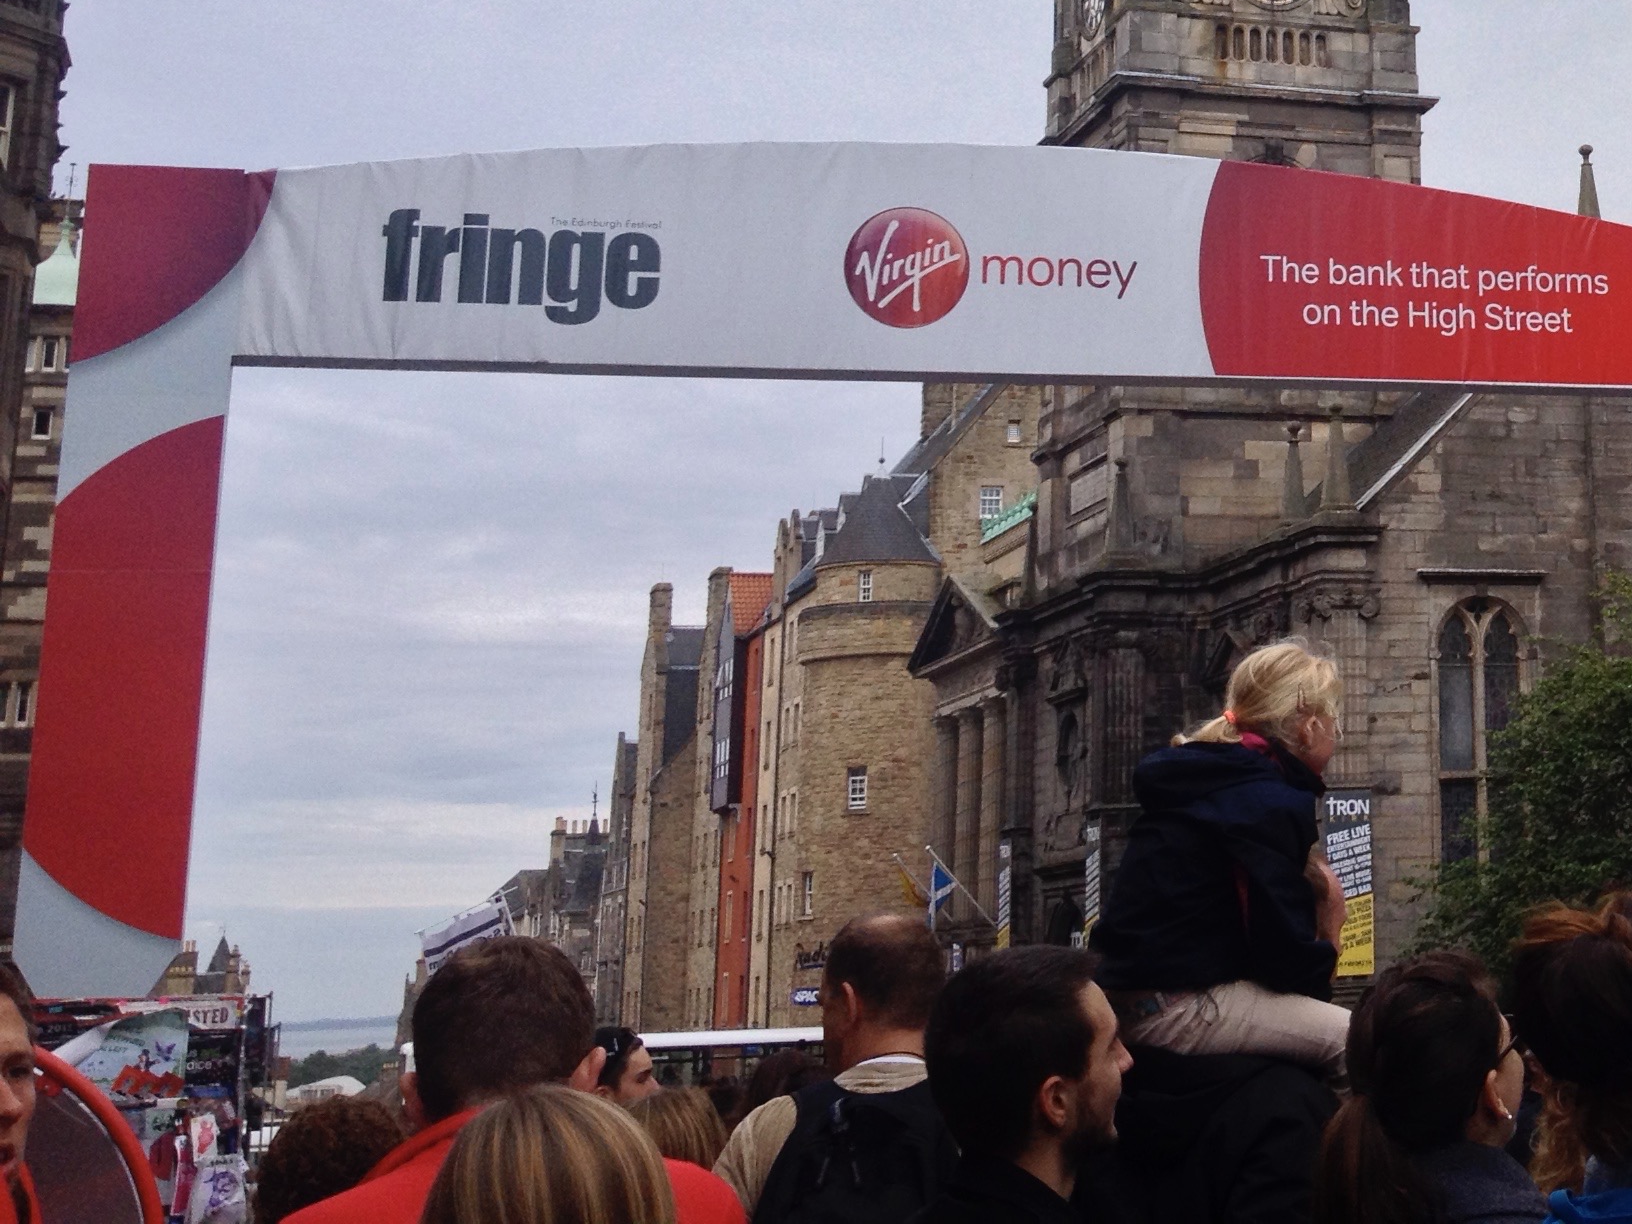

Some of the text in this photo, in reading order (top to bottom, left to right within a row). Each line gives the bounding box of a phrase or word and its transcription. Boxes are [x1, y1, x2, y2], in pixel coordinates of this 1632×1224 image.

[551, 216, 662, 229] The Edinburgh Festival
[382, 209, 661, 325] fringe
[855, 220, 1138, 312] Virgin money
[1259, 255, 1610, 296] The bank that performs
[1302, 300, 1574, 336] on the High Street
[1327, 823, 1371, 845] FREE LIVE
